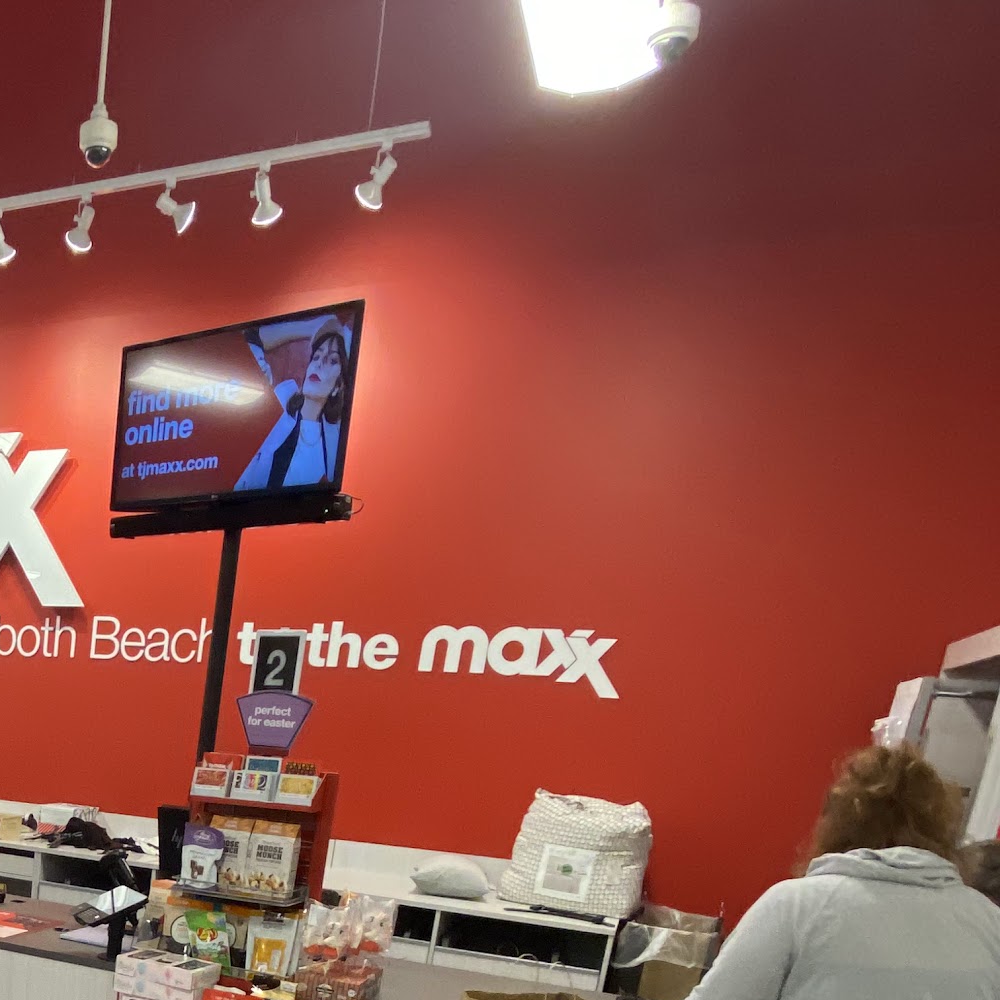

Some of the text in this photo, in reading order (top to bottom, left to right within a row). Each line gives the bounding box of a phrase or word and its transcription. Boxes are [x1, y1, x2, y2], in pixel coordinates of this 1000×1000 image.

[127, 379, 240, 416] find more
[124, 416, 193, 446] online
[121, 456, 218, 480] at tjmaxx.com
[263, 649, 287, 687] 2
[306, 621, 400, 670] the
[418, 625, 620, 699] maxx
[248, 716, 296, 729] for easter
[254, 705, 291, 717] perfect
[256, 851, 283, 861] MUNCH
[257, 844, 284, 854] MOOSE
